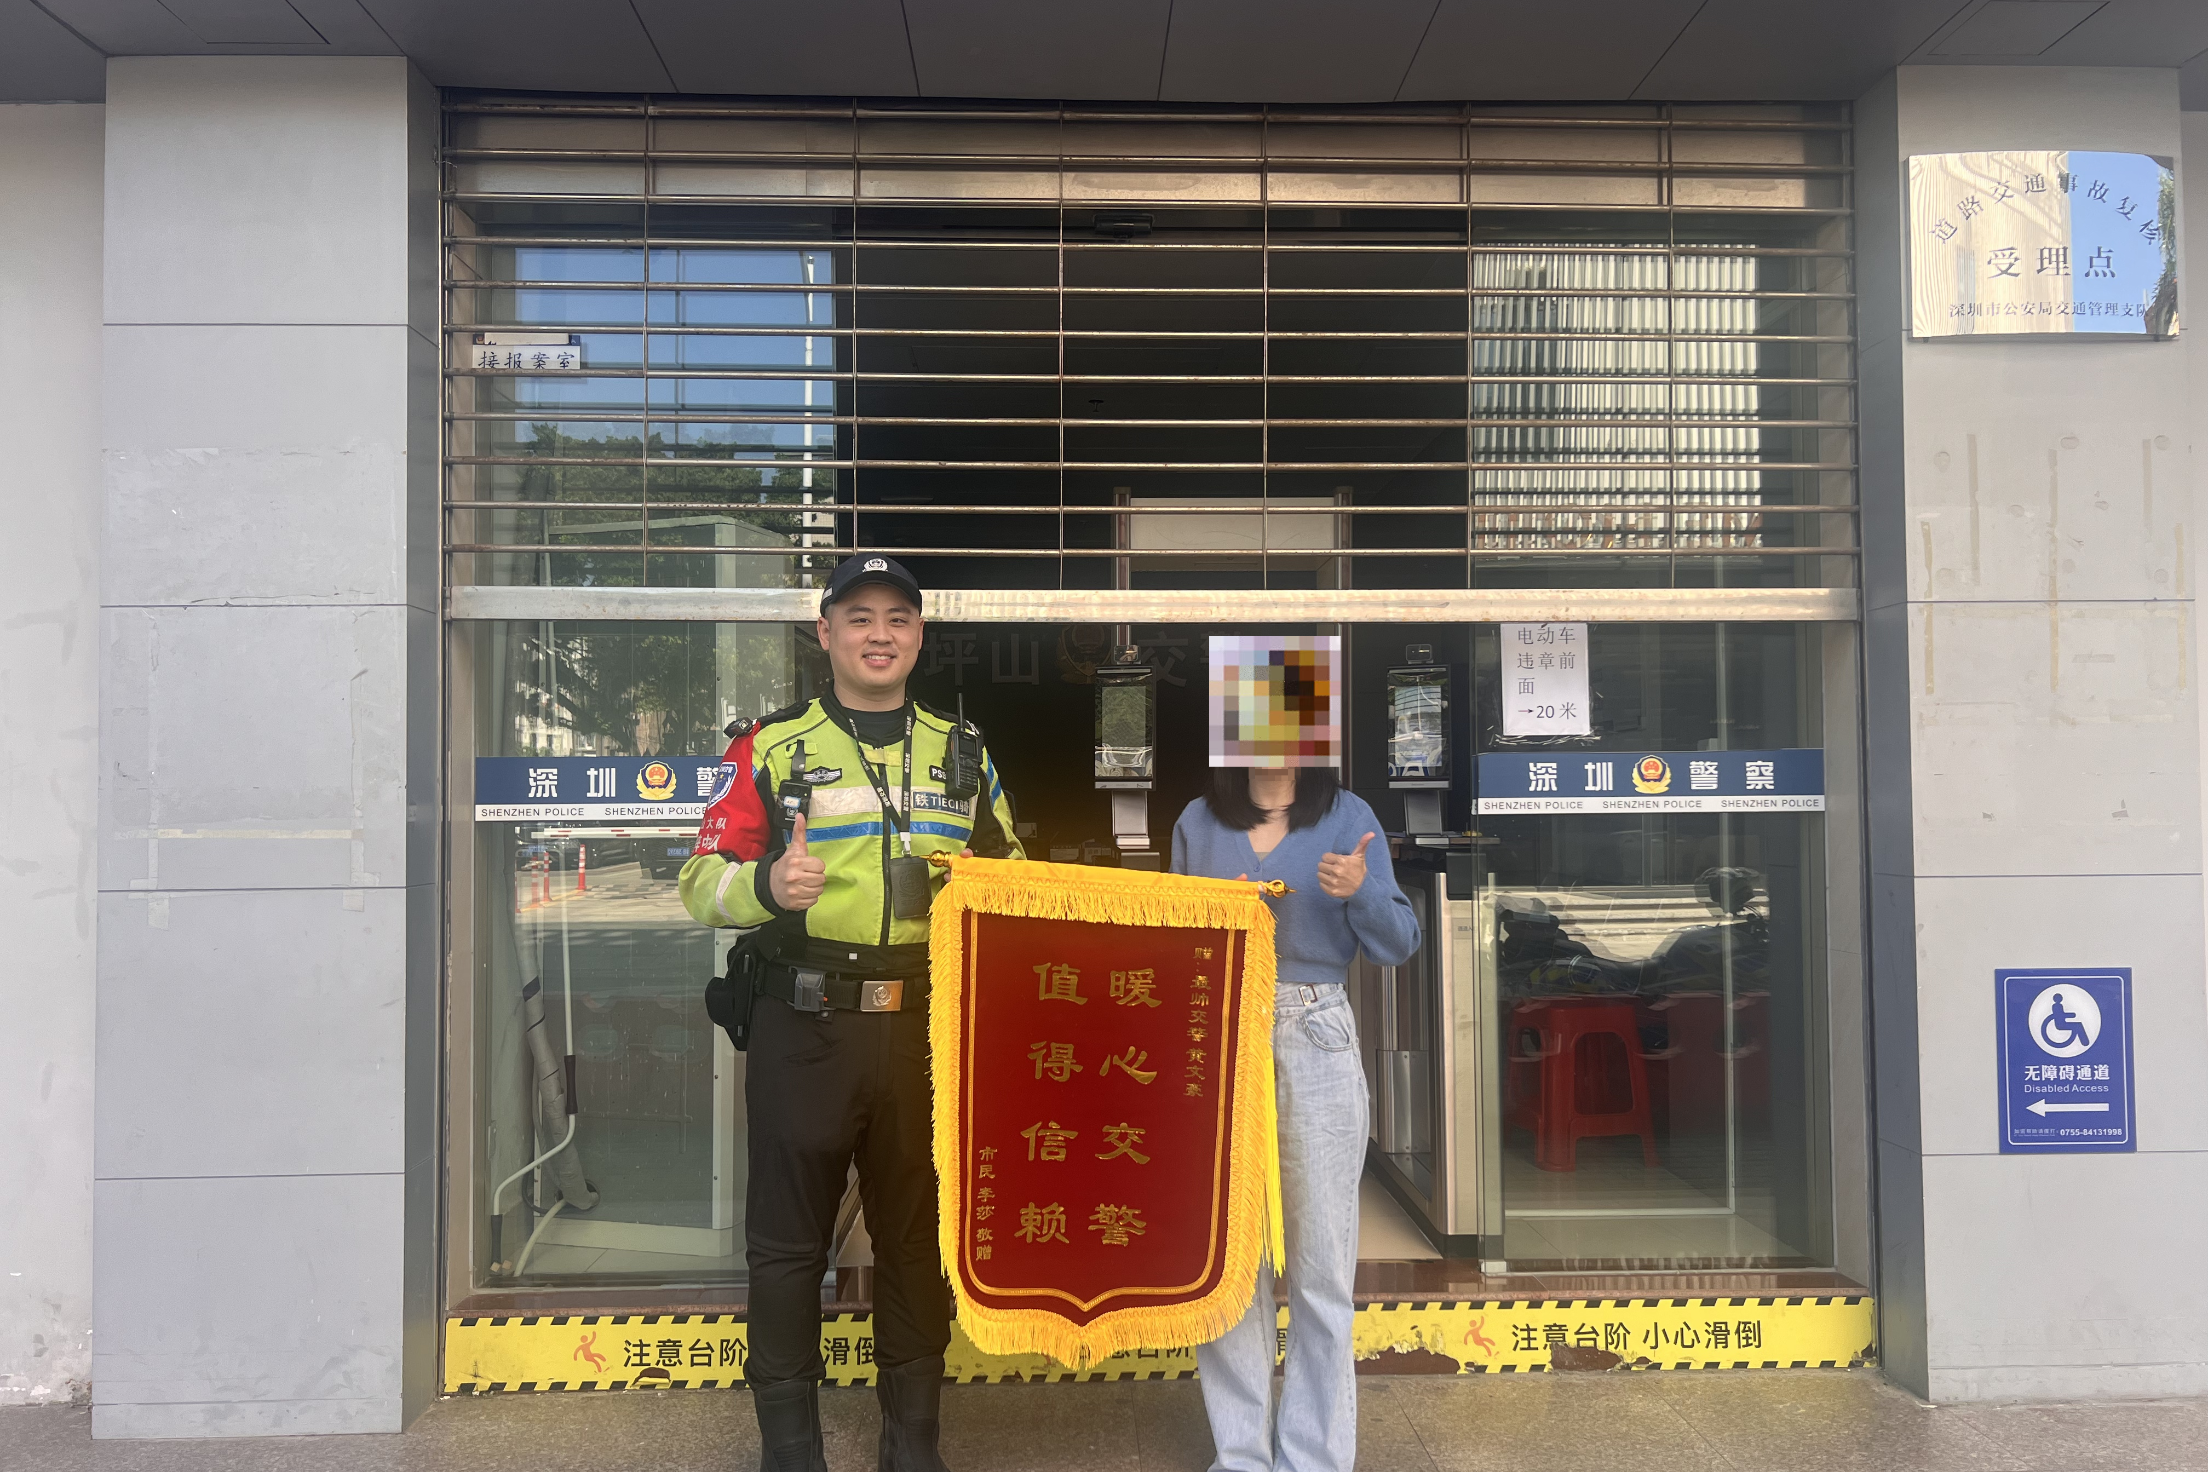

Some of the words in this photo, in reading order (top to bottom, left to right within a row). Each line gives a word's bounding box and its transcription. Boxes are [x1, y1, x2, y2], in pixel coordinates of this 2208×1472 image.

[1987, 246, 2116, 279] 受理点
[1949, 301, 2147, 318] 深圳市公安局交通管理支队
[478, 351, 575, 370] 接报案室
[1518, 626, 1576, 645] 电动车
[924, 632, 1040, 687] 坪山
[1517, 651, 1576, 670] 违章前
[1517, 677, 1535, 695] 面
[481, 808, 540, 817] SHENZHEN
[545, 807, 584, 816] POLICE
[604, 807, 664, 816] SHENZHEN
[1484, 801, 1541, 810] SHENZHEN
[1545, 801, 1584, 810] POLICE
[1602, 800, 1660, 809] SHENZHEN
[1664, 800, 1702, 809] POLICE
[1721, 799, 1778, 808] SHENZHEN
[1782, 799, 1820, 808] POLICE
[2024, 1064, 2110, 1081] 无障碍通道
[2024, 1084, 2070, 1093] Disabled
[2071, 1083, 2109, 1092] Access
[1014, 962, 1088, 1245] 值得信赖
[1087, 968, 1162, 1247] 暖心交警
[1511, 1323, 1631, 1351] 注意台阶
[1642, 1320, 1762, 1350] 小心滑倒
[623, 1338, 748, 1368] 注意台阶
